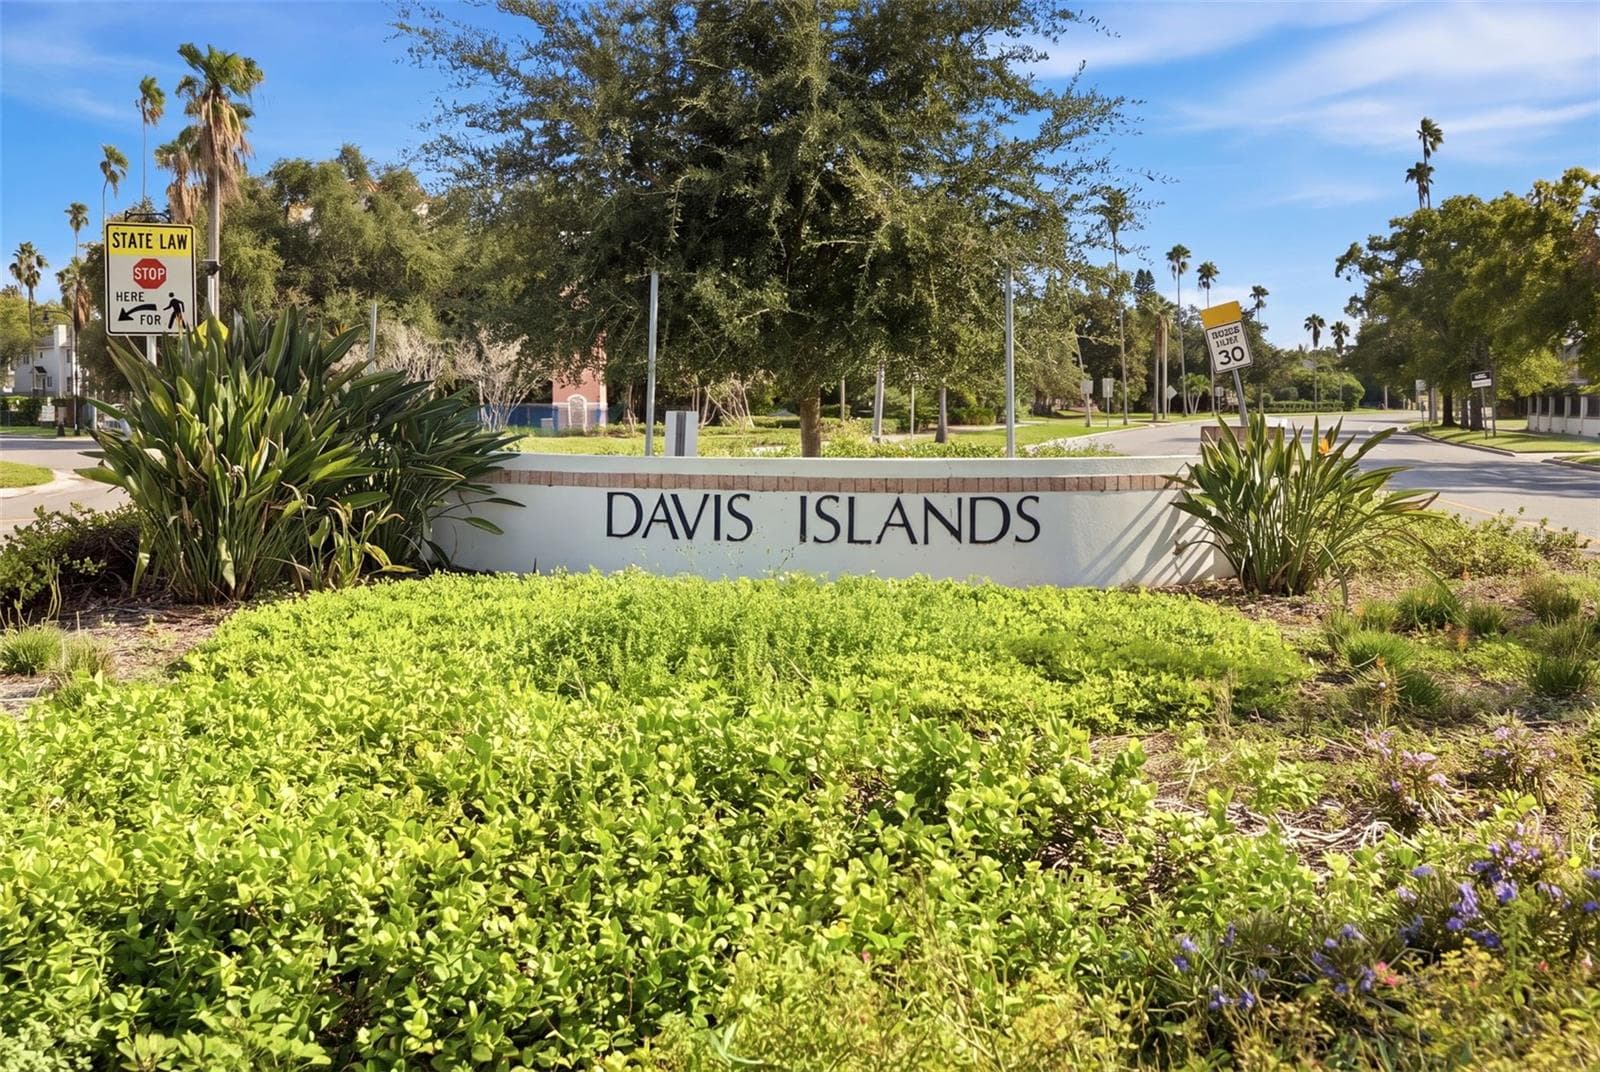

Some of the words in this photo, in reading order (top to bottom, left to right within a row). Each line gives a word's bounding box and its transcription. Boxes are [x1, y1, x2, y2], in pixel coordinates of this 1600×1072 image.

[112, 232, 153, 249] STATE
[160, 234, 187, 250] LAW
[134, 267, 165, 280] STOP
[116, 291, 145, 302] HERE
[140, 314, 161, 325] FOR
[1218, 346, 1245, 365] 30
[606, 491, 753, 542] DAVIS
[799, 494, 1041, 545] ISLANDS
